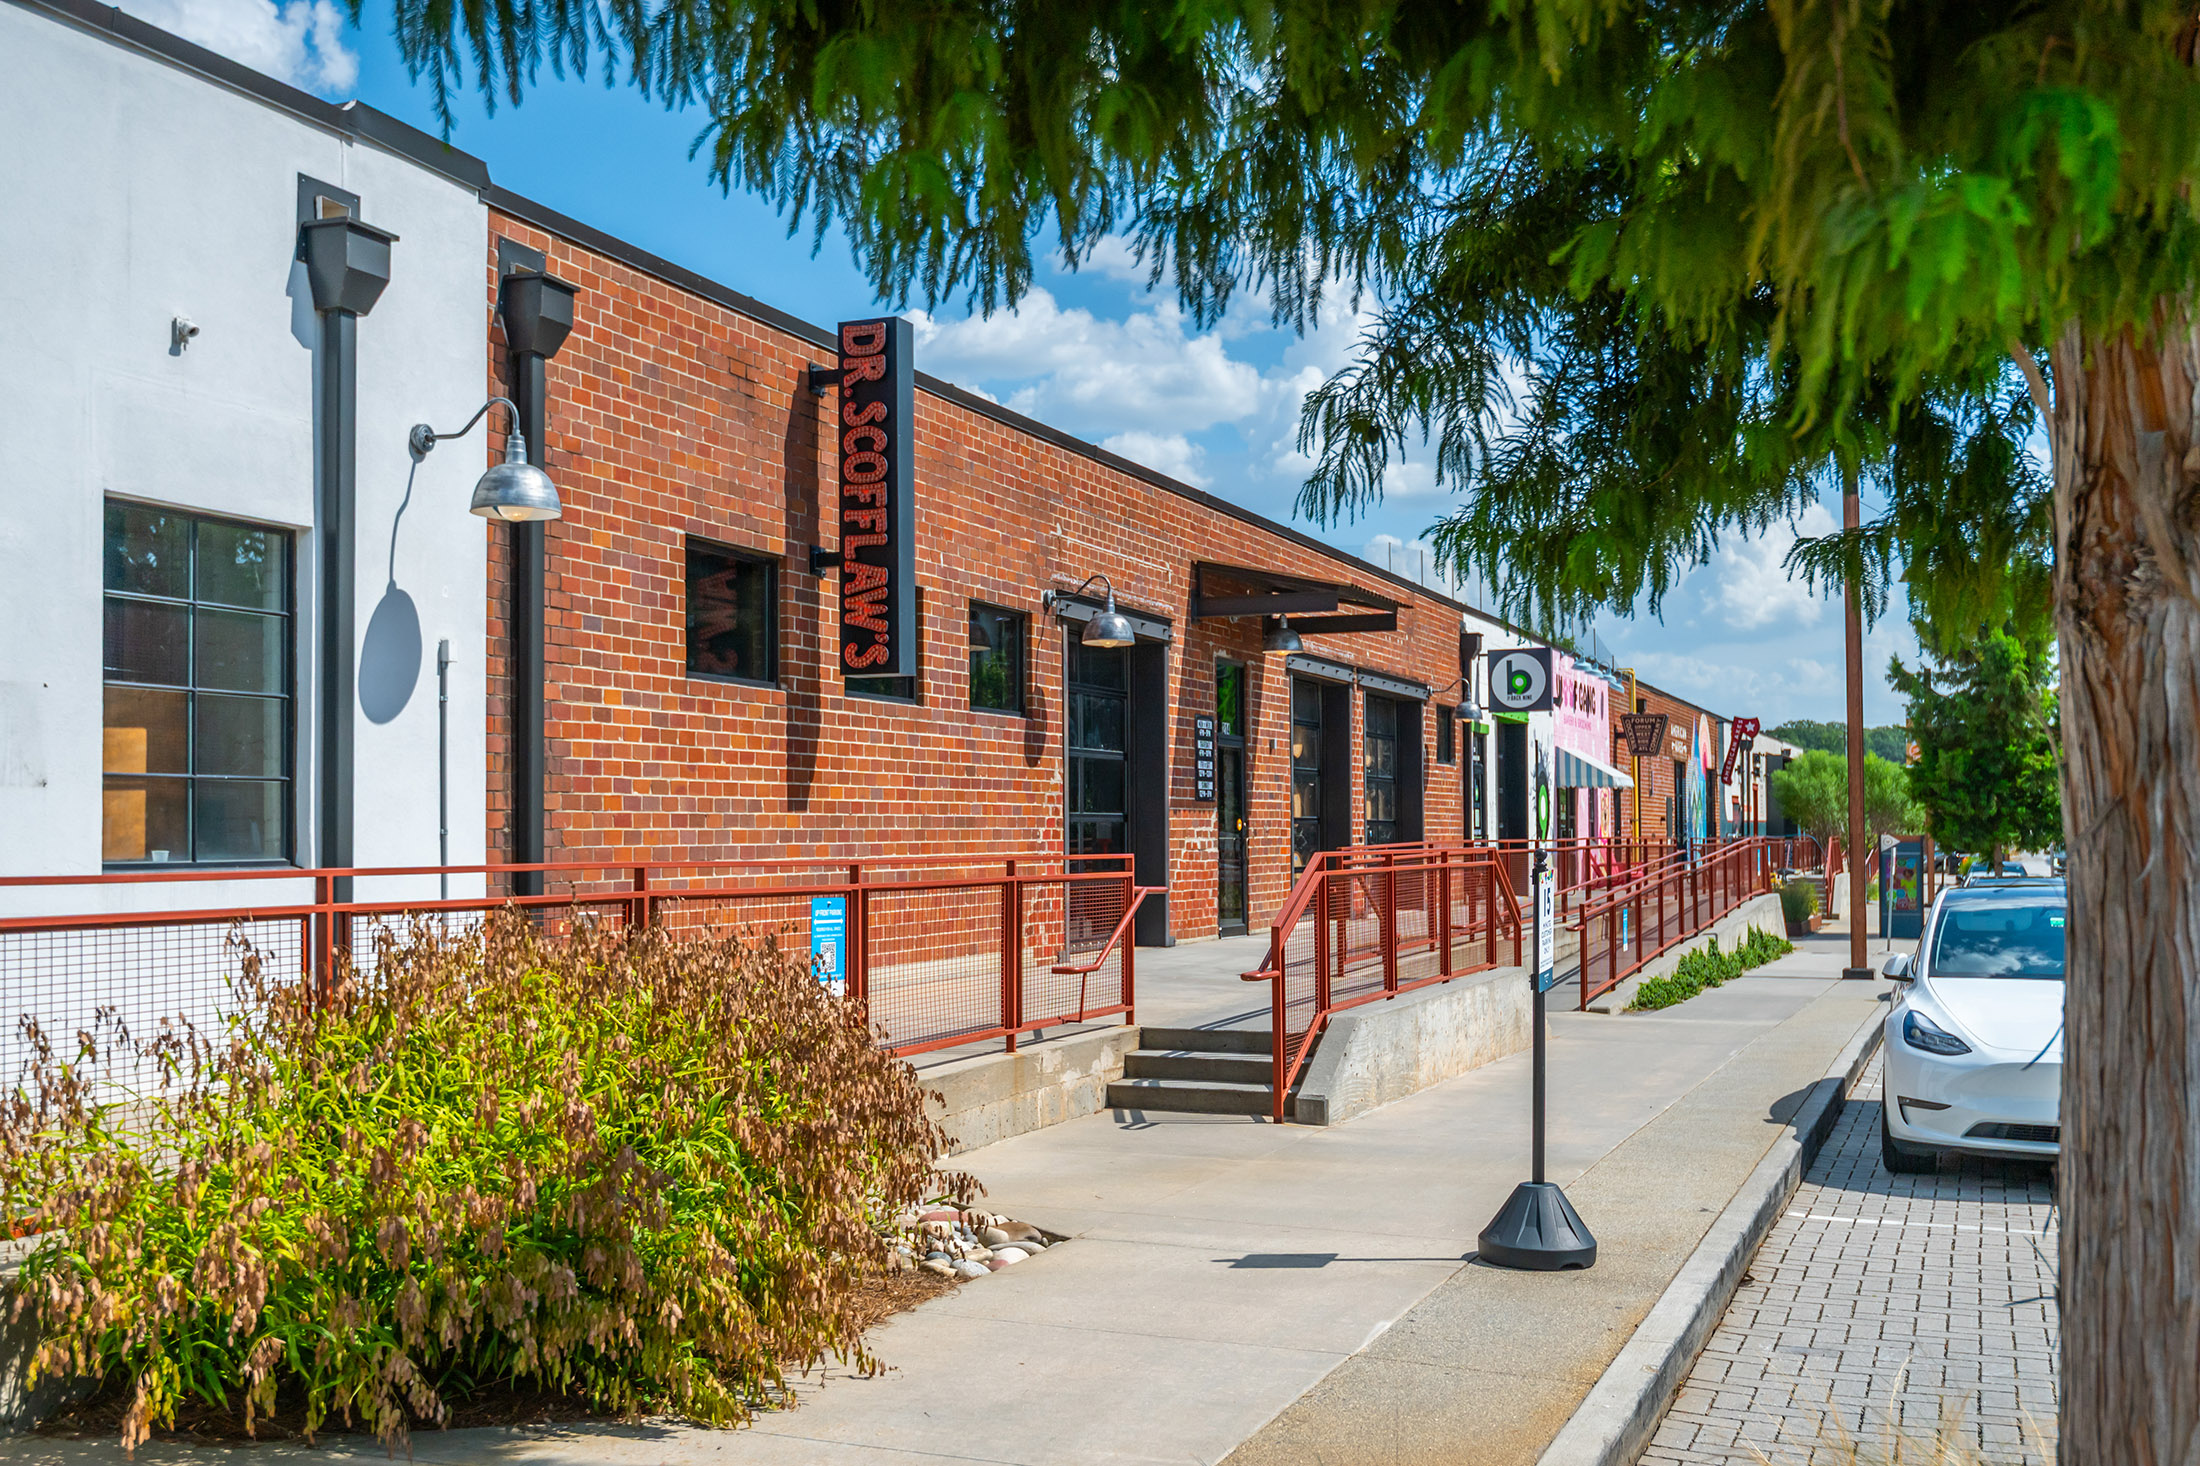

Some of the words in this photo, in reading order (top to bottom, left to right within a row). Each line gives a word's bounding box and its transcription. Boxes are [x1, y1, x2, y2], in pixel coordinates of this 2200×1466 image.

[843, 321, 887, 398] DR.
[843, 400, 890, 669] SCOFFLAW'S
[1579, 683, 1595, 715] GANG
[1649, 718, 1662, 752] COMPANY
[1723, 741, 1737, 781] AMERICAN
[1734, 719, 1744, 739] AXES
[1543, 887, 1551, 917] 15
